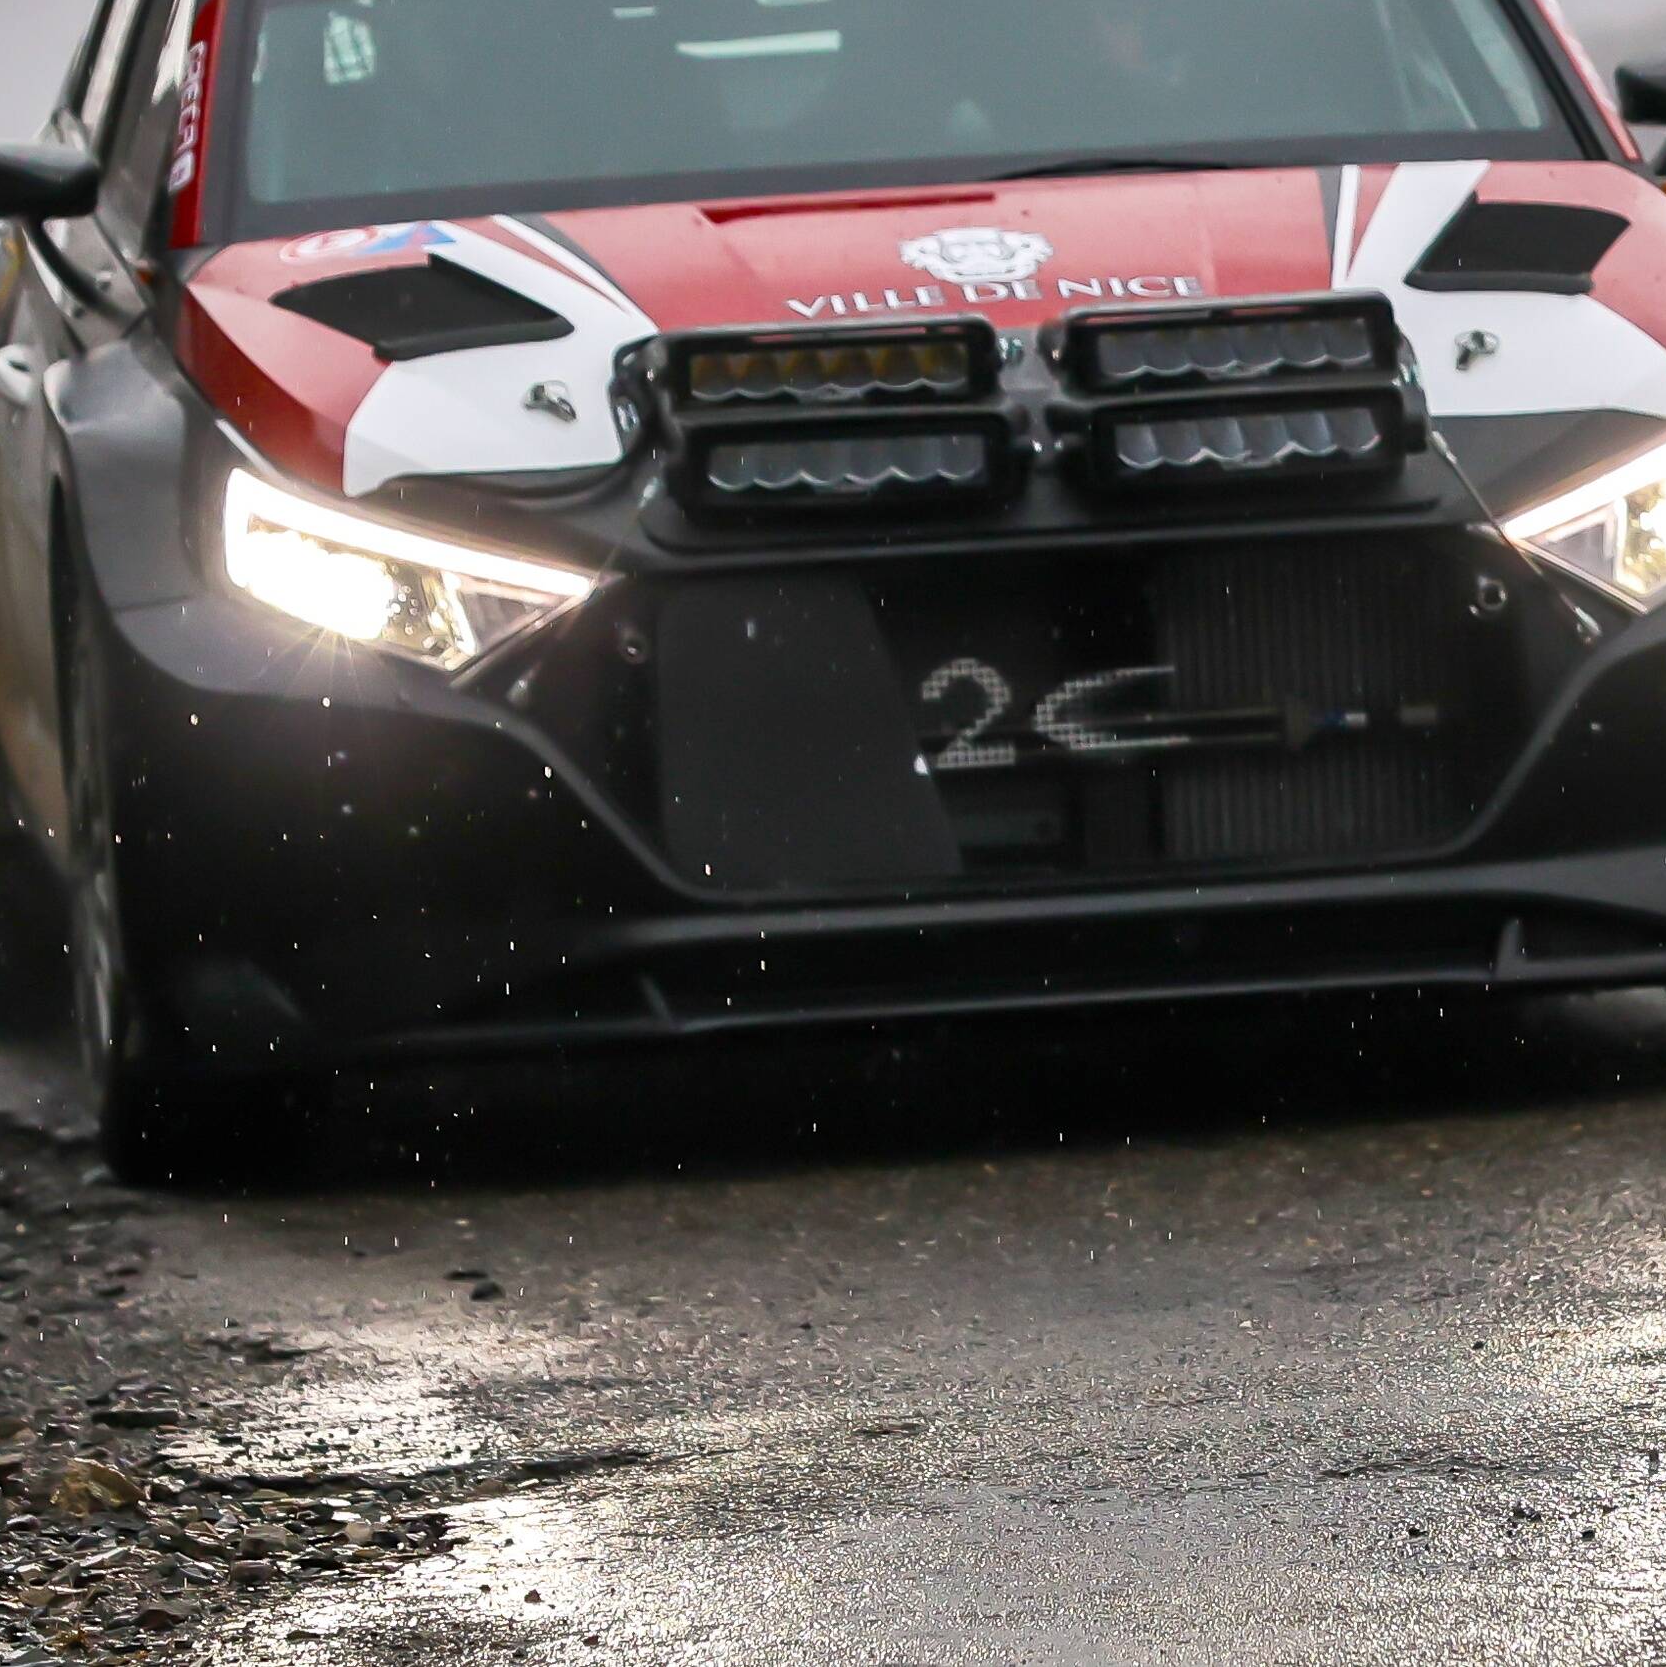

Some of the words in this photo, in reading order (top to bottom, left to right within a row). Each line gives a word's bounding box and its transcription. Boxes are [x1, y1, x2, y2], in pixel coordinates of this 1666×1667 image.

[786, 285, 946, 320] VILLE
[963, 280, 1042, 304] DE
[1057, 275, 1205, 301] NICE
